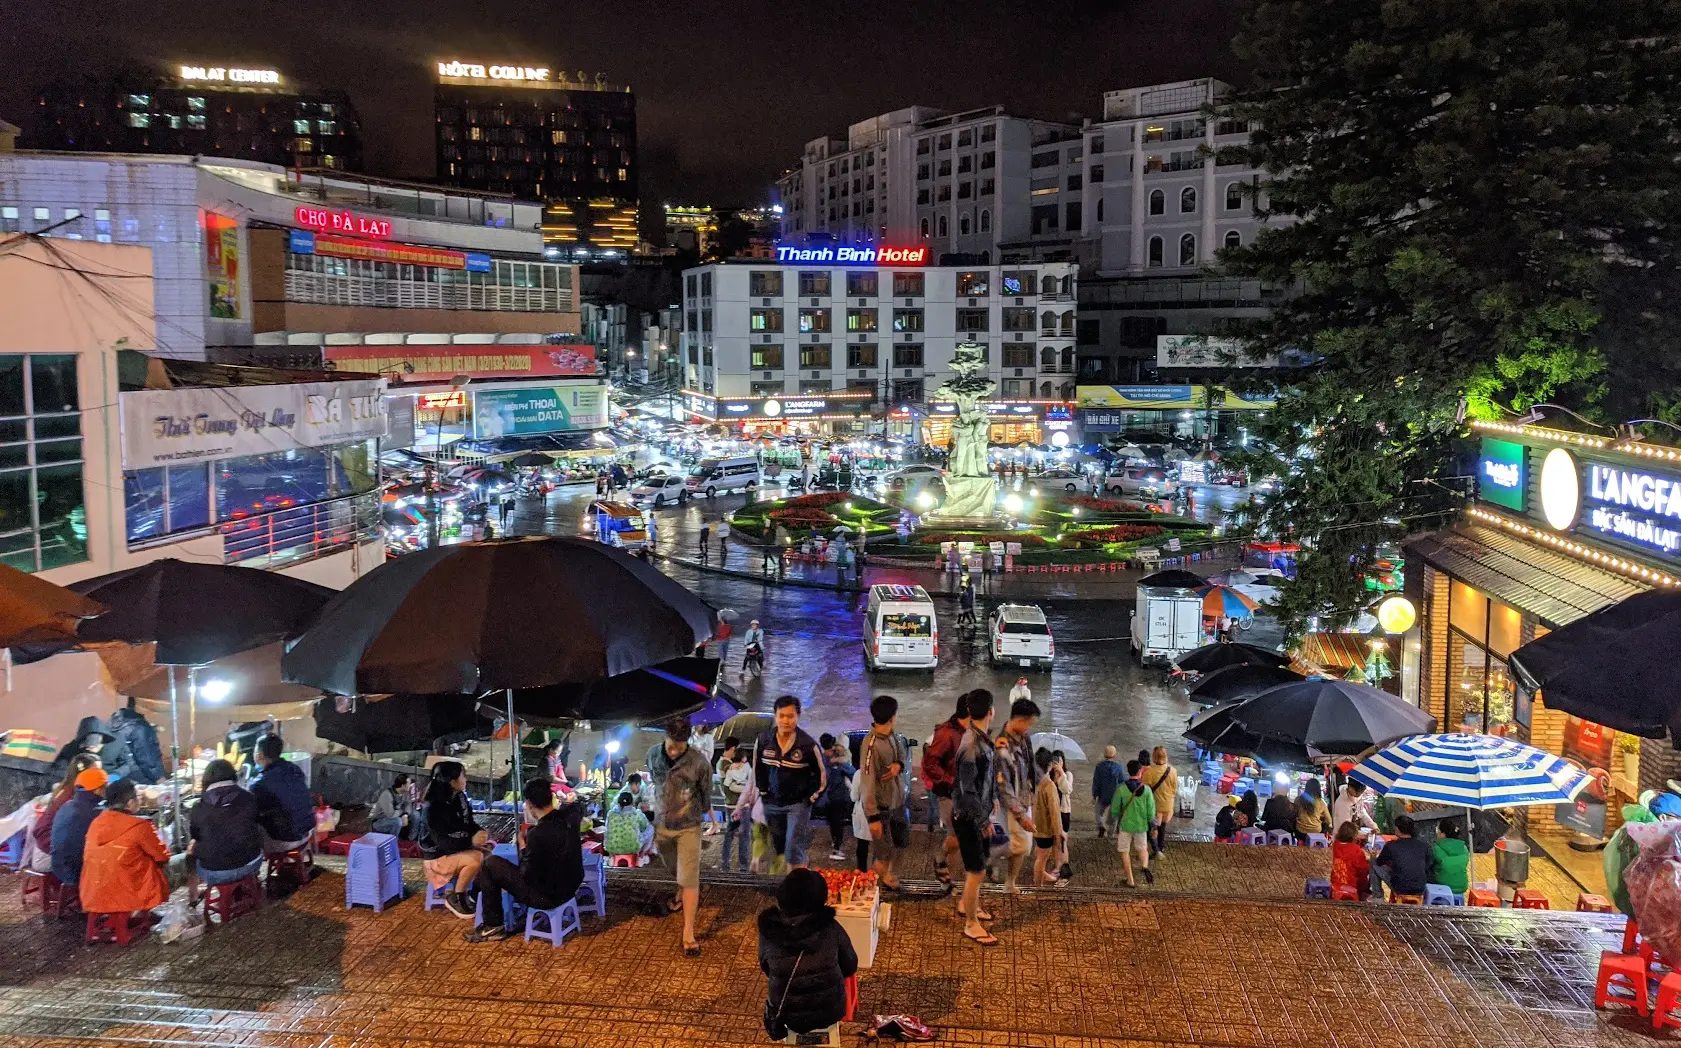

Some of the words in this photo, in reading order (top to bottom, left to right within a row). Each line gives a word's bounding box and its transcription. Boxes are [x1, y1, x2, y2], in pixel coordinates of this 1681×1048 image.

[299, 208, 327, 232] CHỢ
[333, 211, 353, 231] ĐÀ
[360, 218, 389, 239] LẠT
[777, 247, 833, 261] Thanh
[836, 247, 876, 262] Bình
[877, 248, 924, 262] Hotel
[538, 410, 564, 422] DATA
[1111, 415, 1120, 425] XE
[1613, 511, 1636, 538] SẢN
[1636, 518, 1655, 543] ĐÀ
[1654, 526, 1680, 552] LẠT
